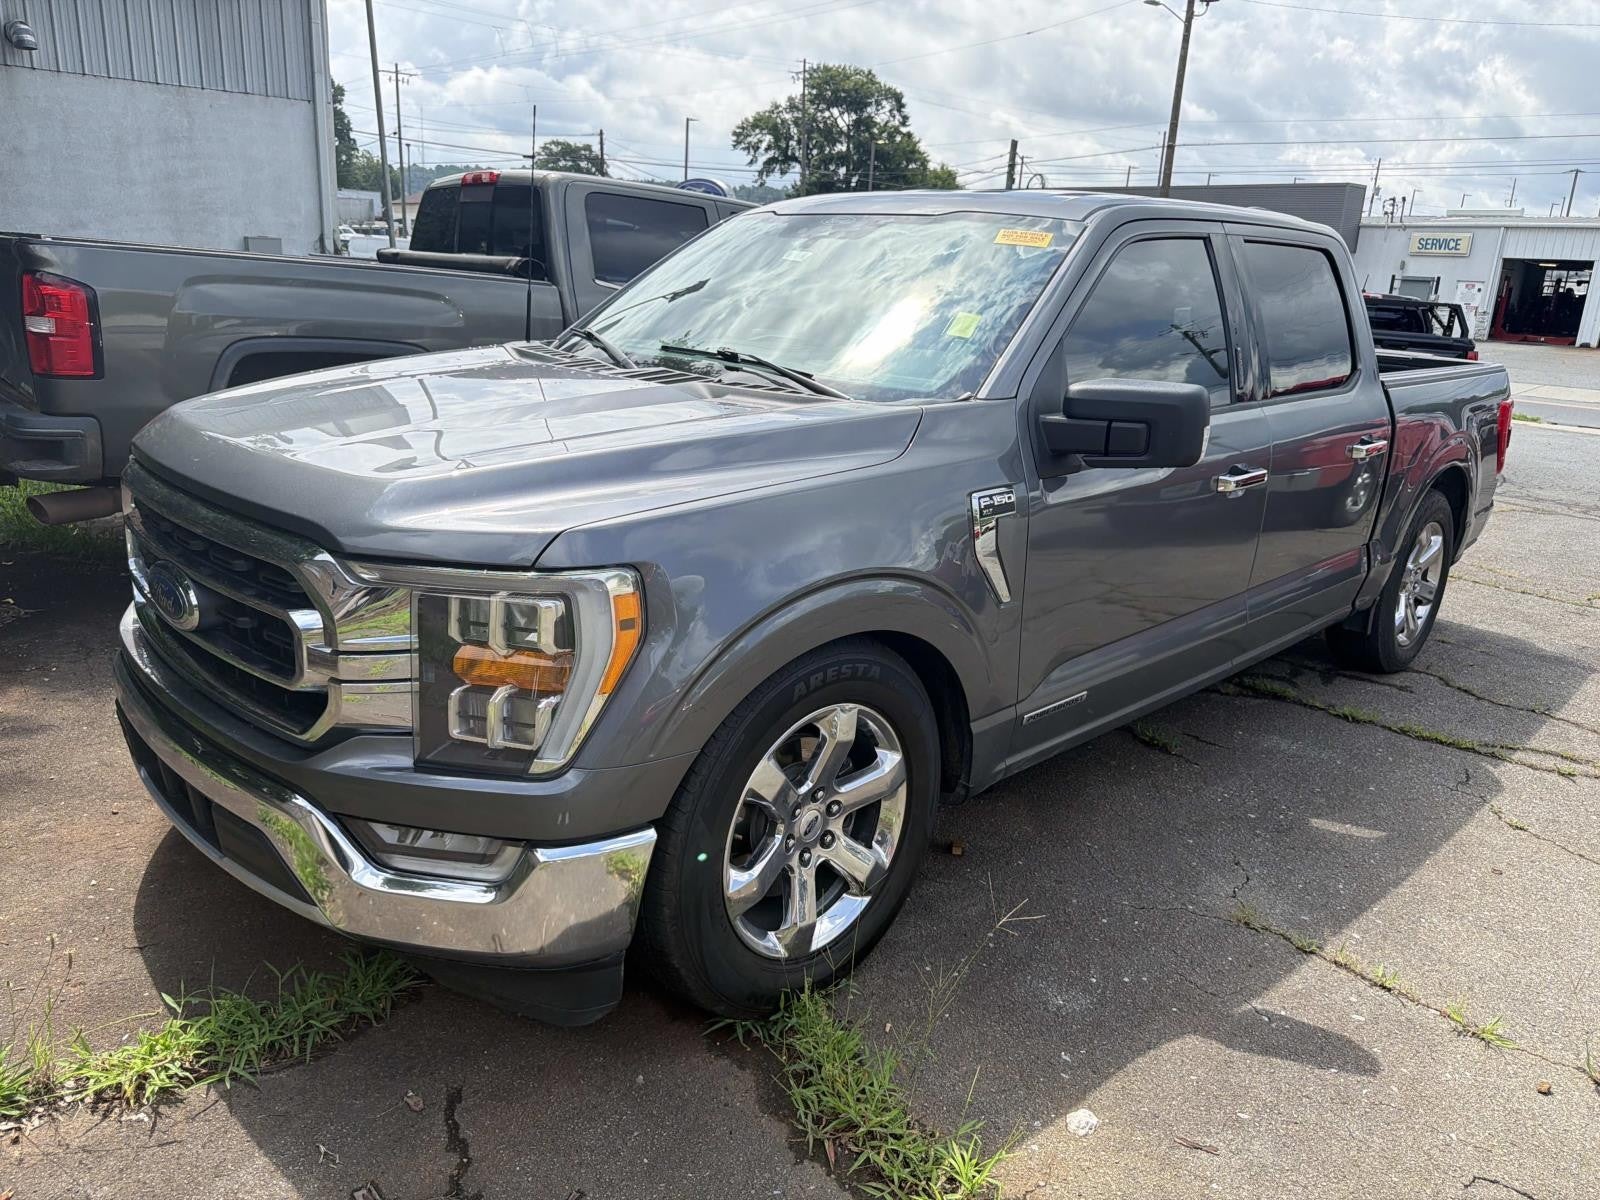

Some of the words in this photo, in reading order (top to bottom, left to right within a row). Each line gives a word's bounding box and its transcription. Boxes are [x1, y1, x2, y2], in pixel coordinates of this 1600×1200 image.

[1417, 237, 1462, 251] SERVICE
[980, 493, 1014, 508] F-150
[793, 663, 881, 703] ARESTA
